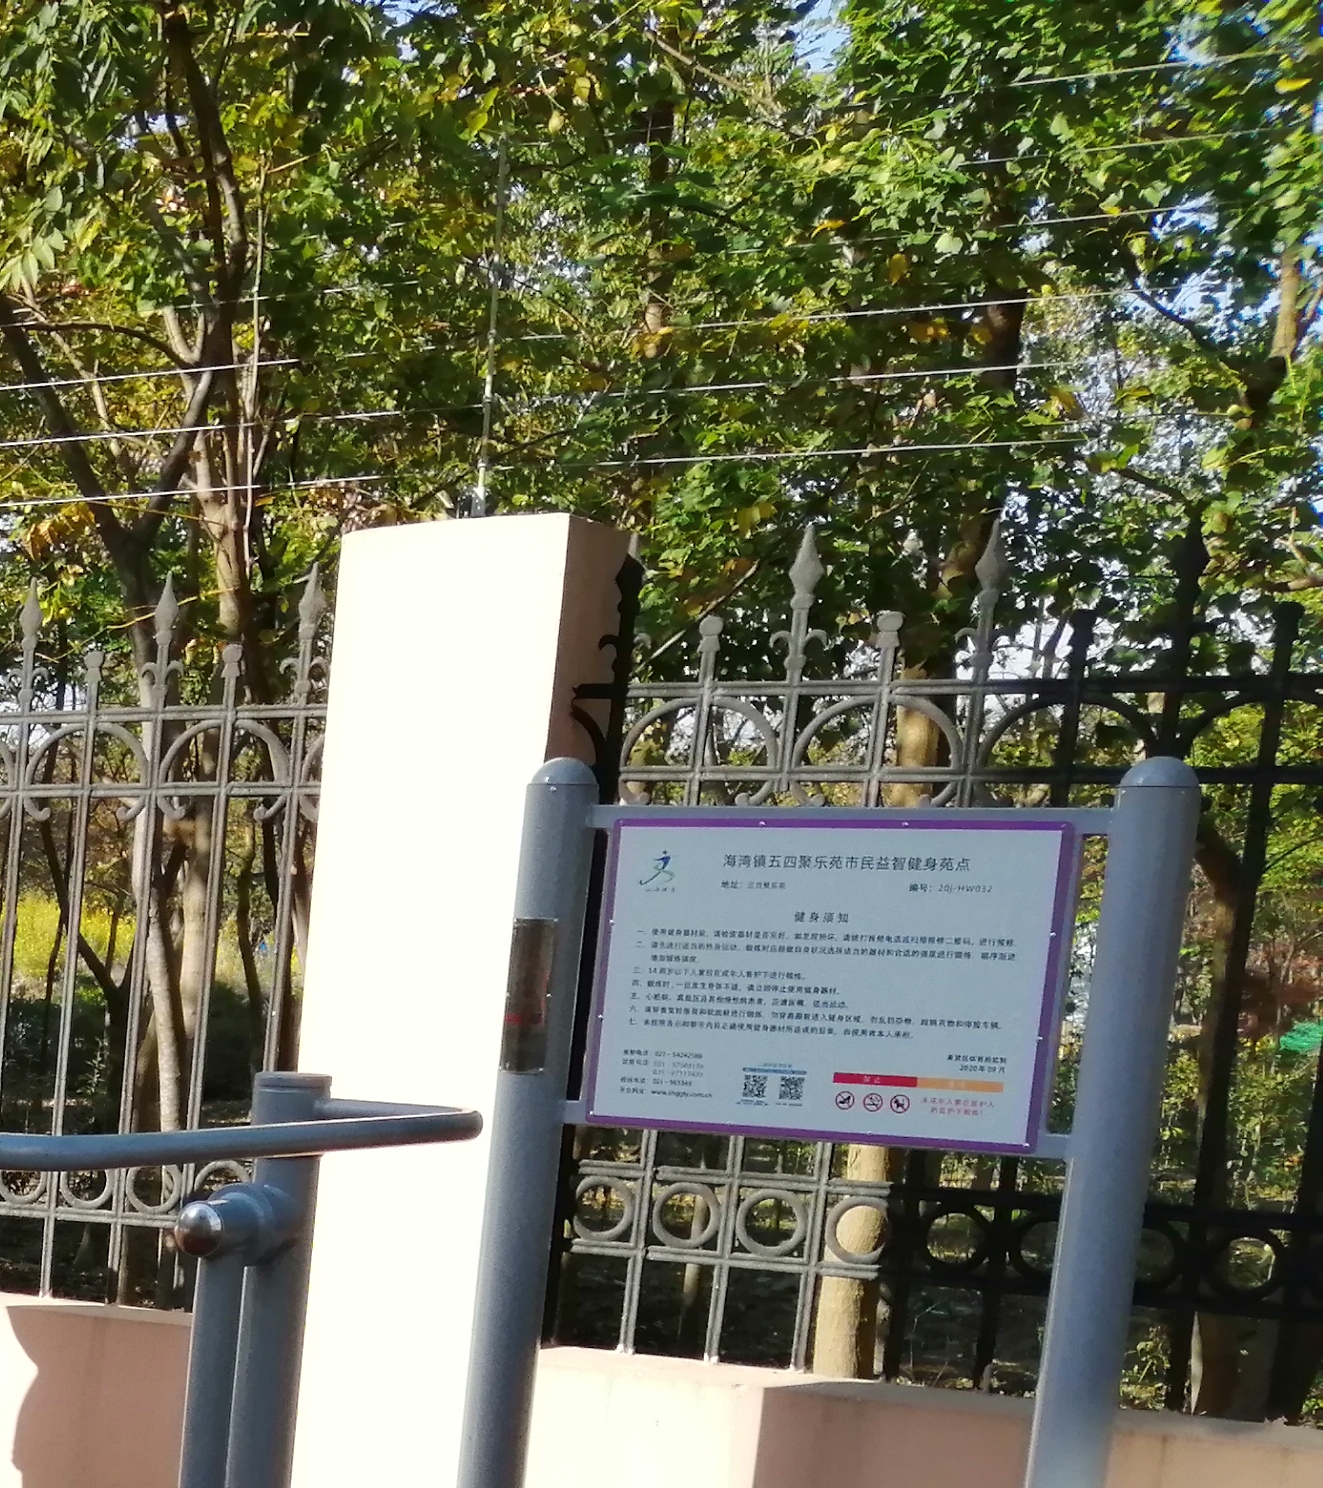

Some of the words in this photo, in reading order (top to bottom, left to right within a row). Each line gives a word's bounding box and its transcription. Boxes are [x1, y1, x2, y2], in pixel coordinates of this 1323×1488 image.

[722, 854, 971, 872] 海湾镇五四聚乐苑市民益智健身苑点
[794, 911, 849, 924] 健身须知
